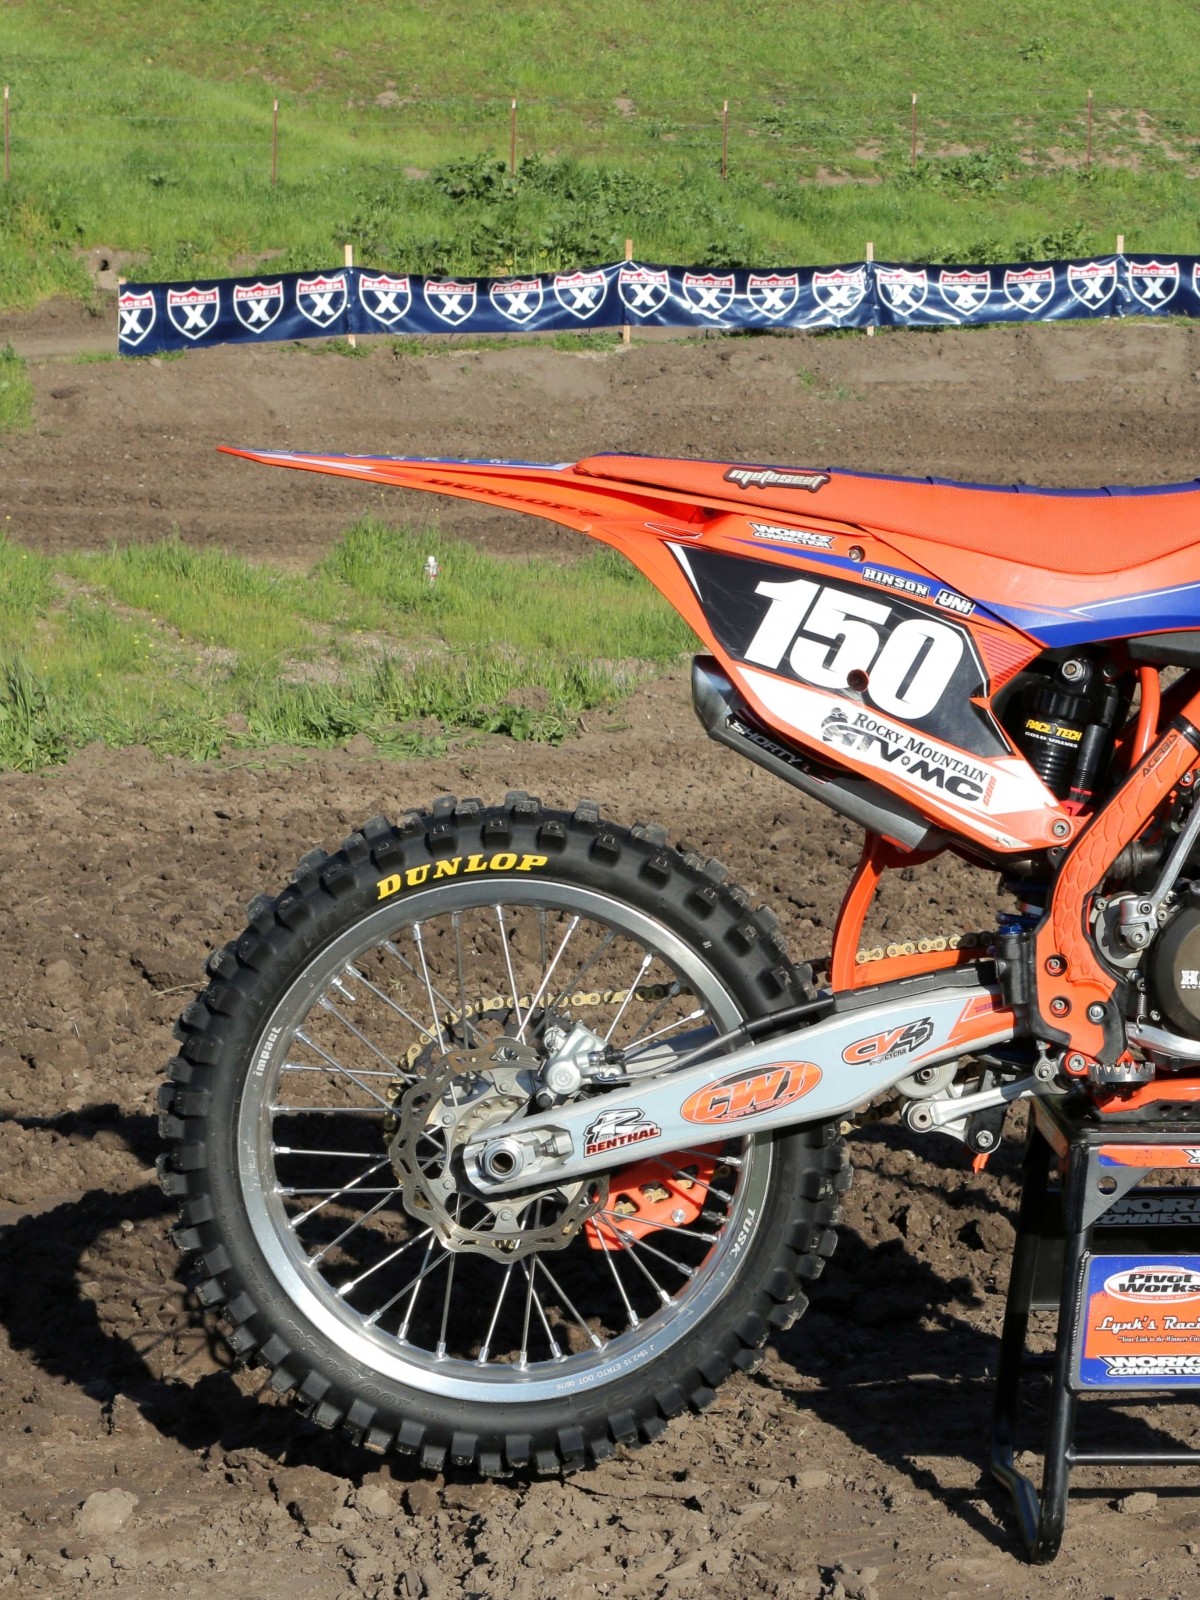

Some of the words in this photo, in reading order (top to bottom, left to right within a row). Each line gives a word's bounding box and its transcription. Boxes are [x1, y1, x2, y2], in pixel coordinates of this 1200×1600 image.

[556, 278, 600, 287] RACER
[622, 274, 665, 283] RACER
[816, 275, 860, 284] RACER
[1008, 273, 1051, 281] RACER
[1071, 268, 1114, 277] RACER
[237, 288, 279, 299] RACER
[301, 282, 342, 292] RACER
[364, 281, 406, 290] RACER
[495, 284, 539, 292] RACER
[630, 284, 657, 306] X
[826, 286, 852, 307] X
[887, 284, 916, 306] X
[953, 285, 978, 307] X
[1018, 282, 1044, 304] X
[1082, 278, 1105, 299] X
[1142, 277, 1167, 299] X
[119, 299, 150, 307] ACER
[171, 295, 214, 303] RACER
[310, 292, 336, 317] X
[374, 291, 400, 314] X
[438, 294, 466, 315] X
[504, 292, 532, 314] X
[569, 287, 596, 309] X
[696, 287, 723, 309] X
[761, 288, 786, 309] X
[120, 310, 144, 334] X
[182, 304, 208, 329] X
[247, 299, 271, 323] X
[751, 523, 835, 542] WORKS
[754, 532, 832, 549] CONNECTION
[864, 568, 929, 596] HINSON
[744, 578, 964, 720] 150
[1025, 719, 1053, 734] RACE
[1056, 727, 1083, 741] TECH
[851, 712, 904, 745] ROCKY
[903, 737, 989, 783] MOUNTAIN
[377, 852, 549, 901] DUNLOP
[586, 1128, 659, 1155] RENTHAL
[729, 1208, 756, 1258] TUSK
[1128, 1273, 1194, 1283] Pivot
[1095, 1316, 1157, 1334] Lynk's
